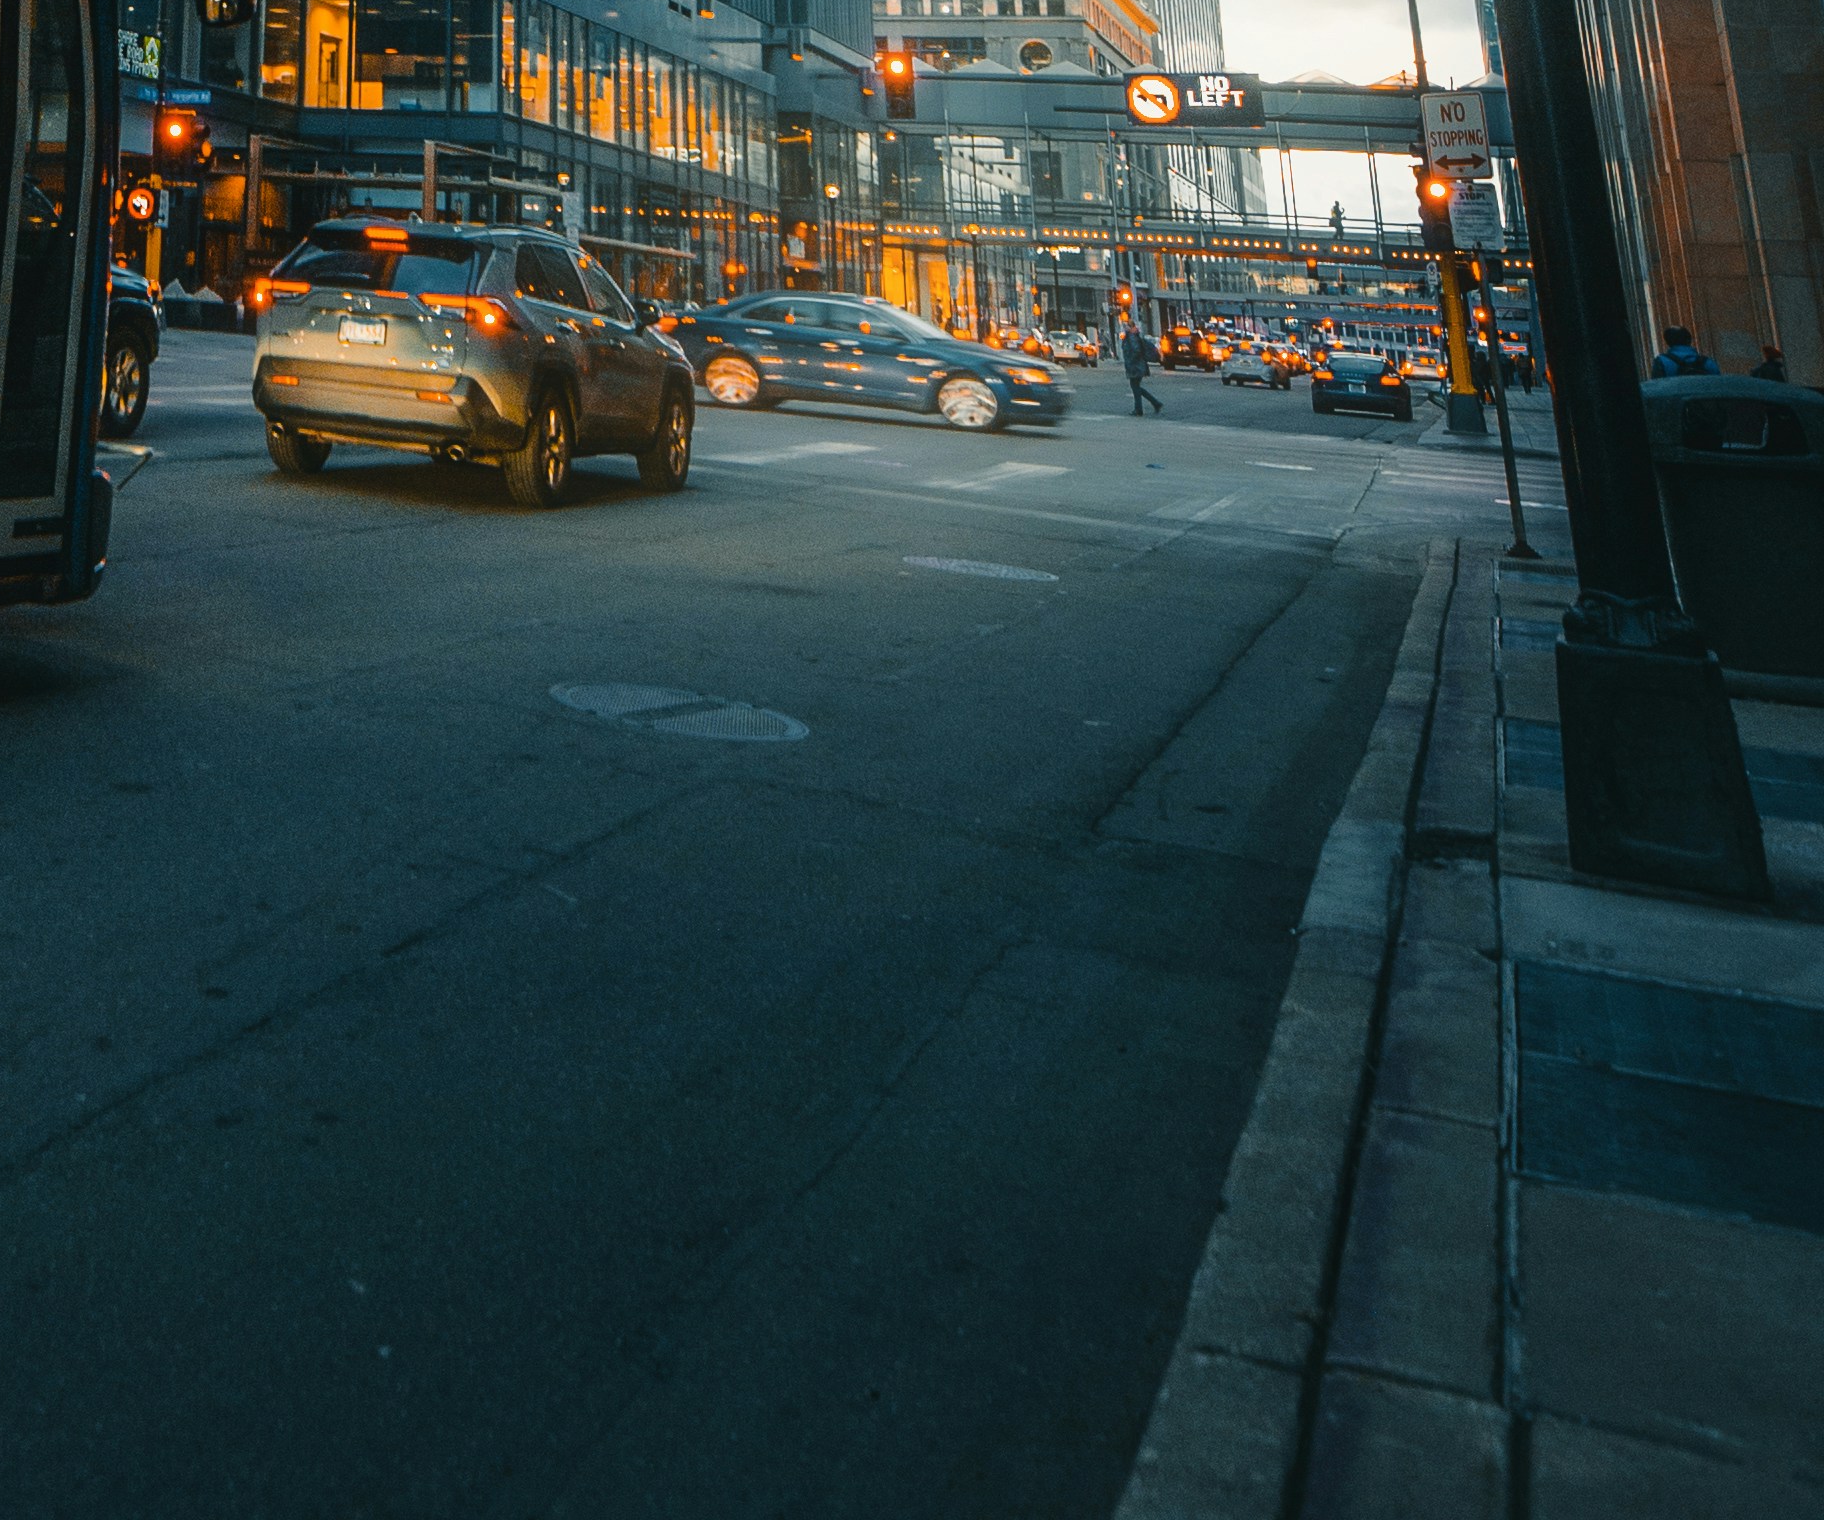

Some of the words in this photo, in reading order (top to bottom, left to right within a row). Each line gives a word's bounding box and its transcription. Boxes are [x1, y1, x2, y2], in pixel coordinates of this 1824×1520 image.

[1199, 75, 1231, 91] NO
[1186, 90, 1246, 108] LEFT
[1440, 102, 1466, 124] NO
[1430, 129, 1484, 148] STOPPING
